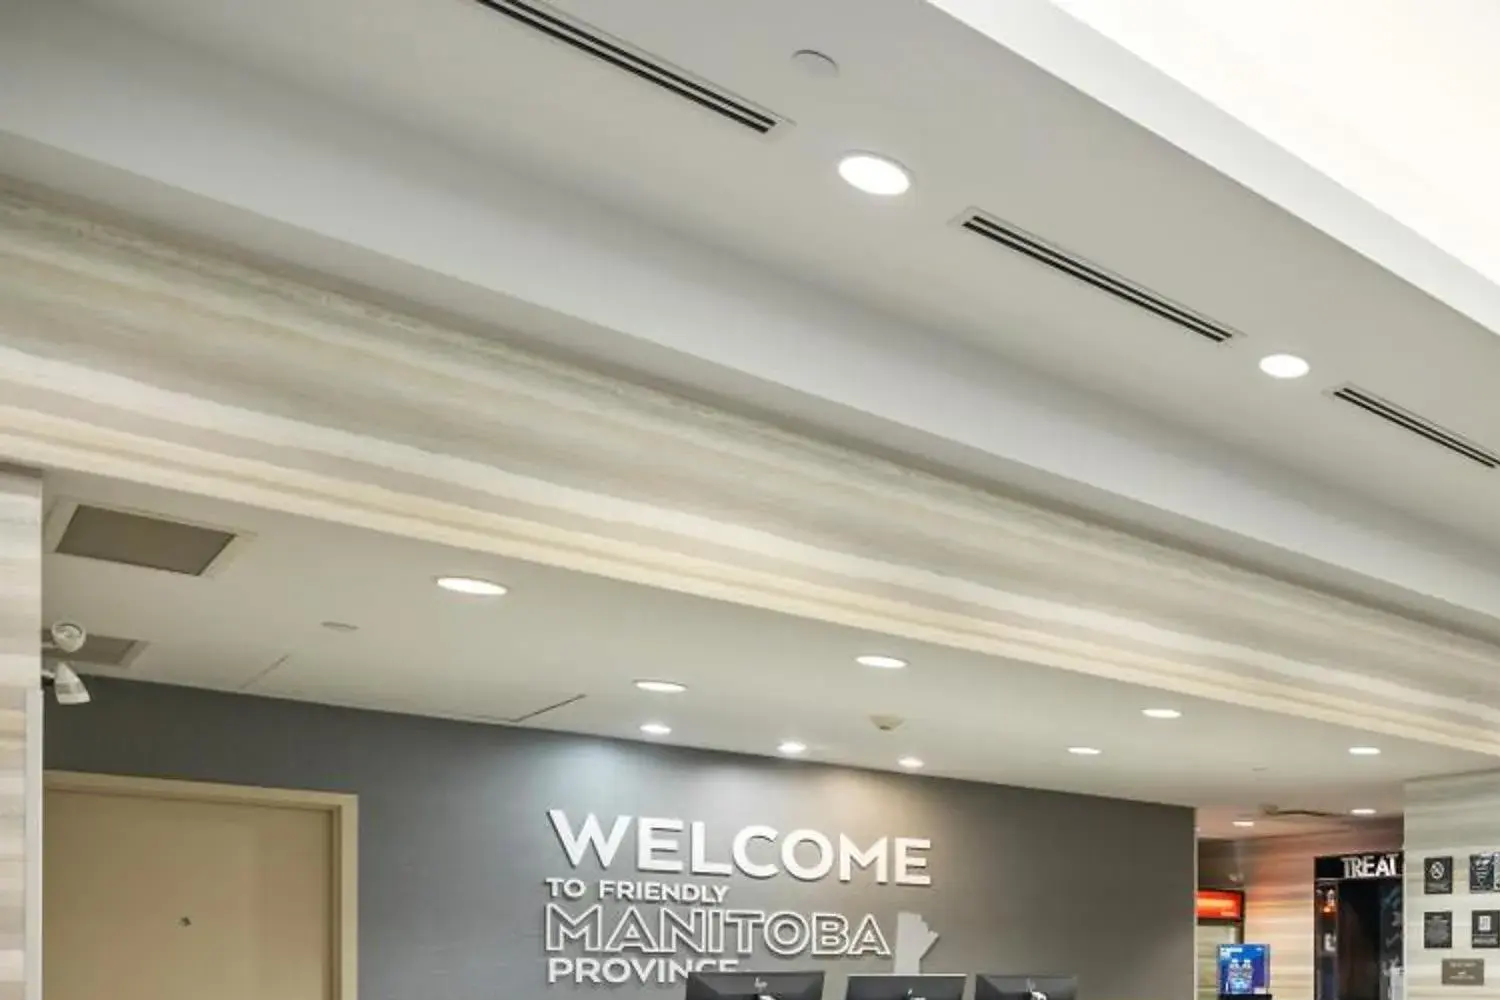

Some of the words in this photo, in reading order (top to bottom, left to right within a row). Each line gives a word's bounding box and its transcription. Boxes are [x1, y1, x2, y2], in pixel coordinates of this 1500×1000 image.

[546, 809, 932, 886] WELCOME
[545, 878, 587, 897] TO
[600, 879, 730, 904] FRIENDLY
[545, 903, 892, 956] MANITOBA
